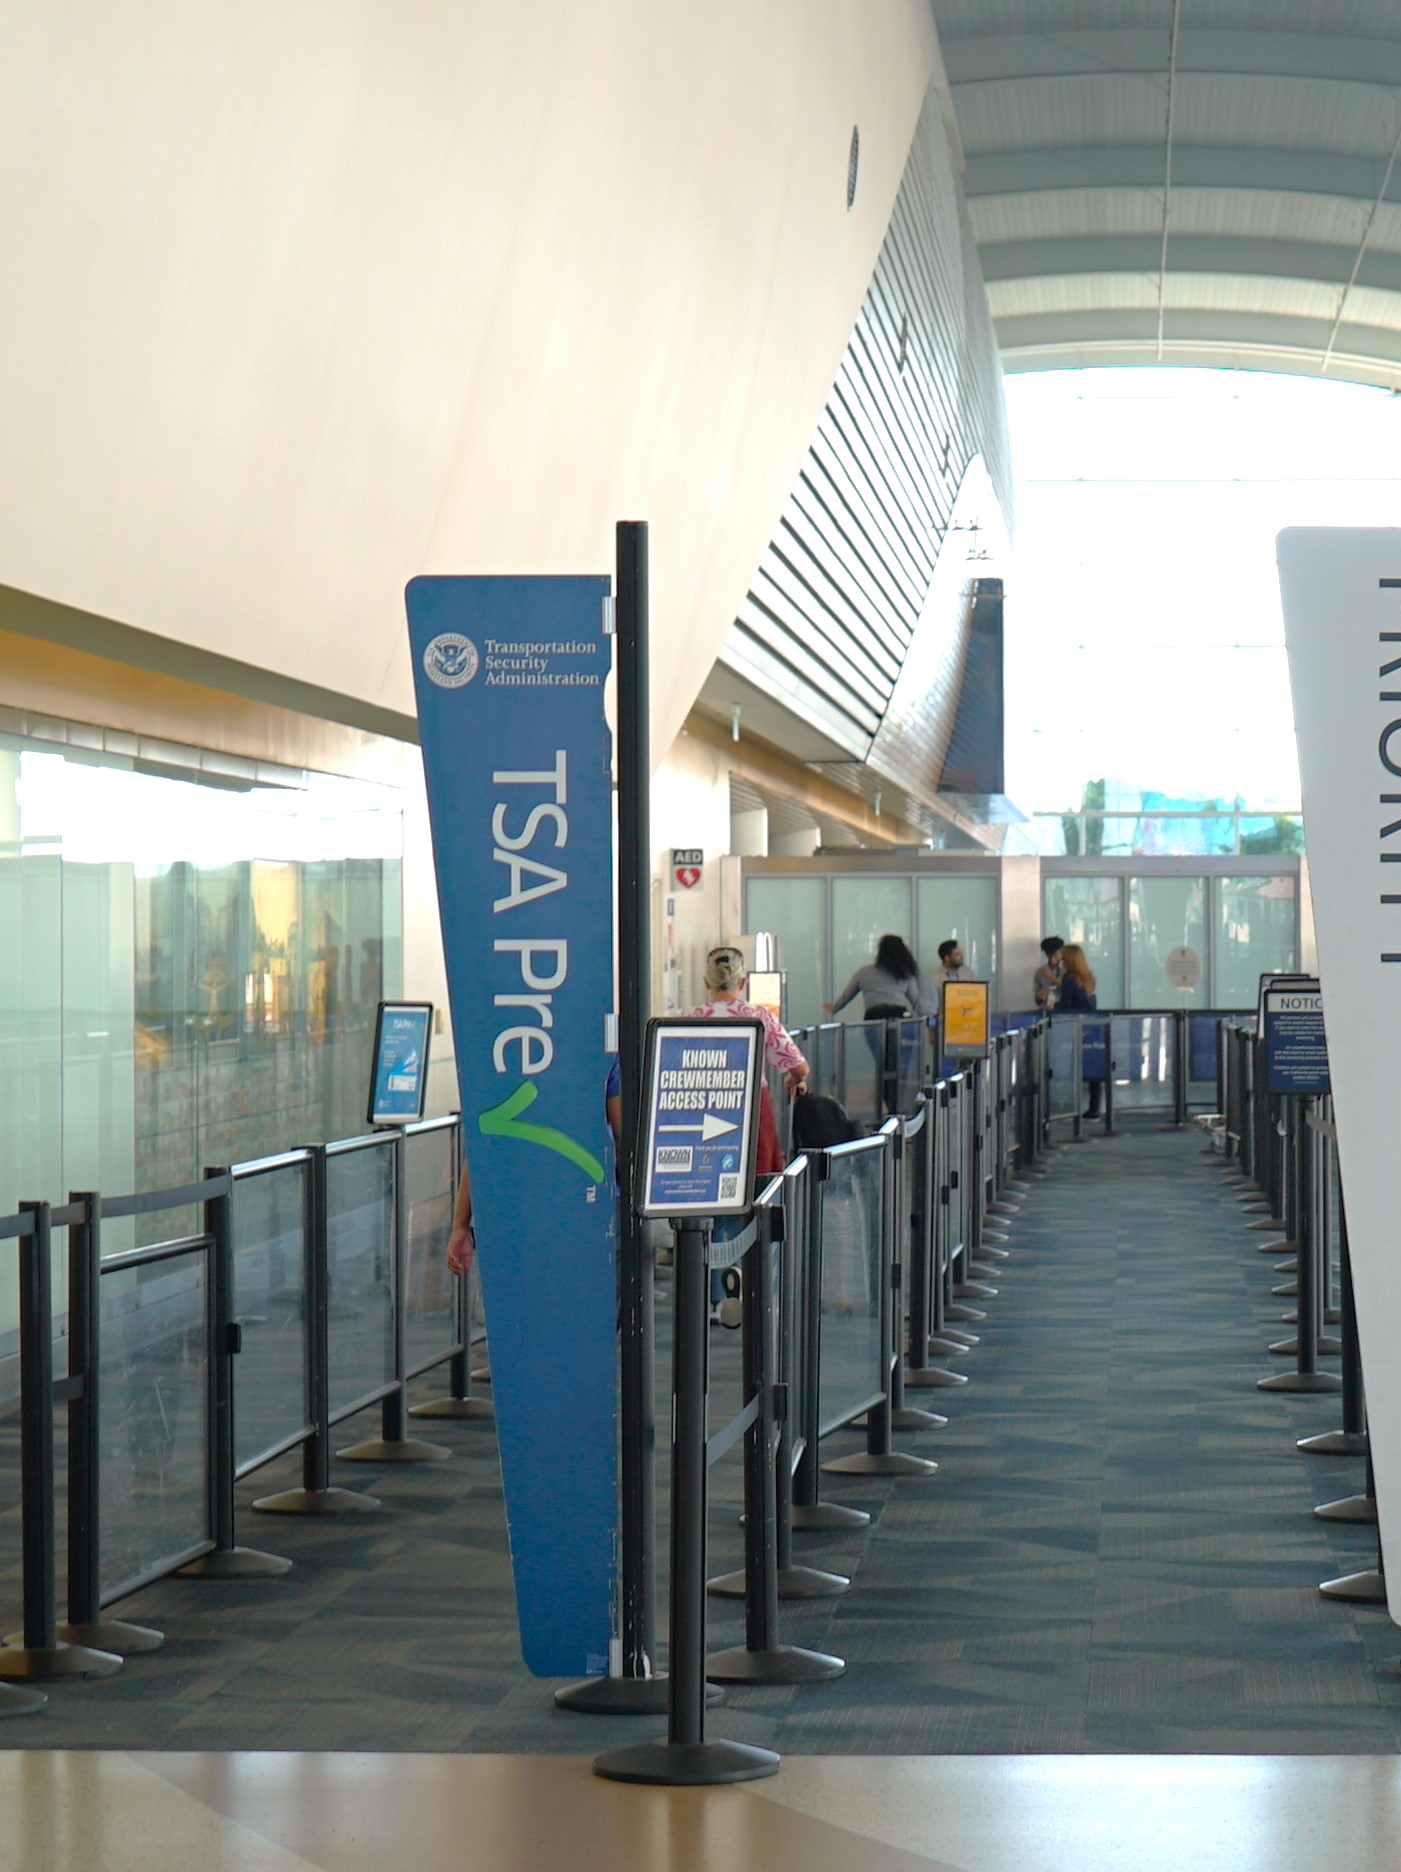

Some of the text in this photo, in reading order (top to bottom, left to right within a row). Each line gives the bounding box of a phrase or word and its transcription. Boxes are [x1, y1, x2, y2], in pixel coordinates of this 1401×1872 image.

[484, 639, 596, 657] Transportation
[484, 656, 548, 674] Security
[484, 672, 599, 686] Administration
[674, 851, 703, 864] AED
[491, 749, 568, 1075] TSA Pre
[1280, 997, 1322, 1009] NOTIC
[682, 1049, 728, 1069] KNOWN
[660, 1070, 745, 1090] CREWMEMBER
[658, 1090, 744, 1111] ACCESS POINT
